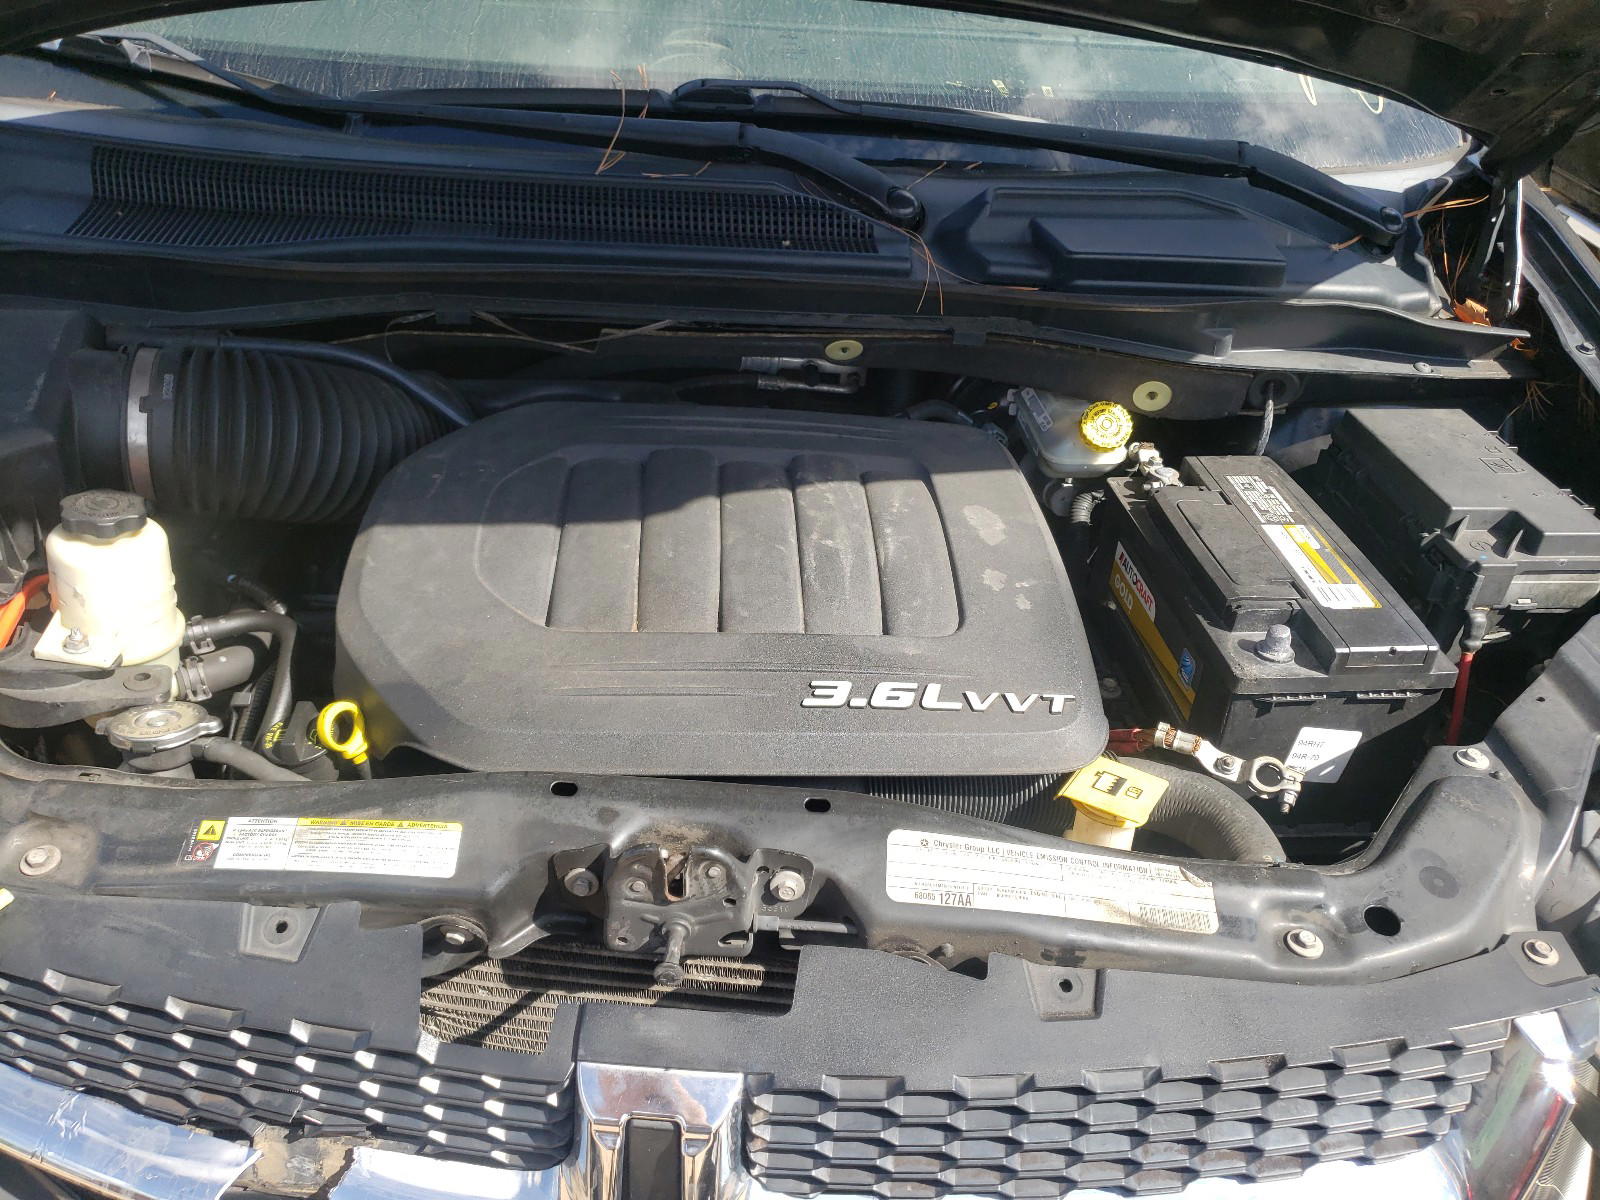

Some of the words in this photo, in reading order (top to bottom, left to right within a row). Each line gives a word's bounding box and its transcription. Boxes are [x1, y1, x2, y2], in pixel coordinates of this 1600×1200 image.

[1115, 574, 1134, 610] GOLD
[1121, 557, 1153, 611] AUTOCRAFT
[964, 843, 985, 853] Group
[987, 846, 1001, 855] LLC
[1036, 851, 1068, 864] EMISSION
[1070, 857, 1099, 868] CONTROL
[1102, 861, 1148, 874] INFORMATION
[939, 892, 972, 907] 127AA
